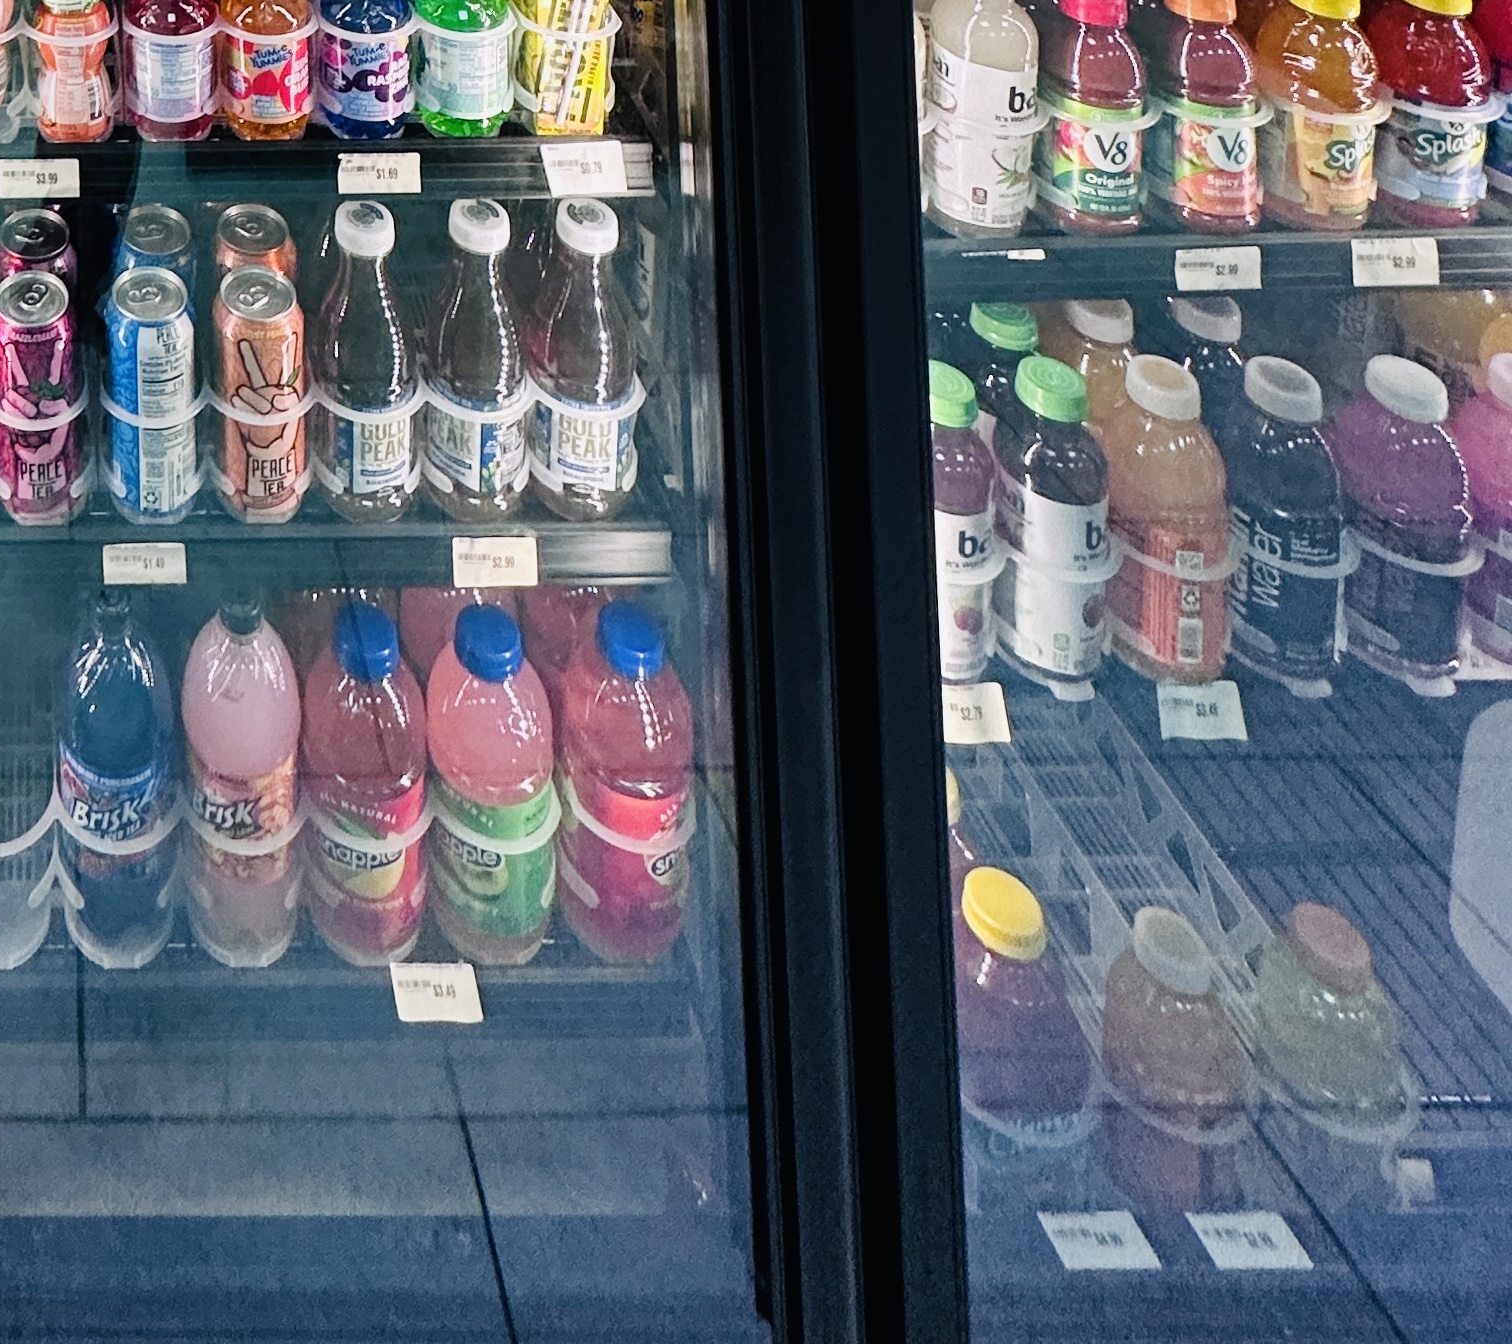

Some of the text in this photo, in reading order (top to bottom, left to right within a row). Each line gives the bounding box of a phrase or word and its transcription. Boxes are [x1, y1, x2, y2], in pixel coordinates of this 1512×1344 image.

[1094, 131, 1128, 166] V8
[1217, 131, 1249, 165] V8
[1415, 126, 1482, 161] Splash
[36, 172, 58, 185] $3.99
[375, 167, 399, 180] $1.69
[1084, 172, 1135, 189] Original
[1207, 174, 1239, 189] Spicy
[1392, 256, 1416, 269] $2.99
[155, 327, 181, 346] PEACE
[359, 438, 407, 462] PEAK
[557, 433, 611, 459] PEAK
[20, 459, 64, 480] PEACE
[252, 457, 293, 479] PEACE
[31, 484, 55, 499] TEA
[262, 481, 287, 496] TEA
[492, 555, 516, 569] $2.99
[340, 798, 398, 823] NATURAL
